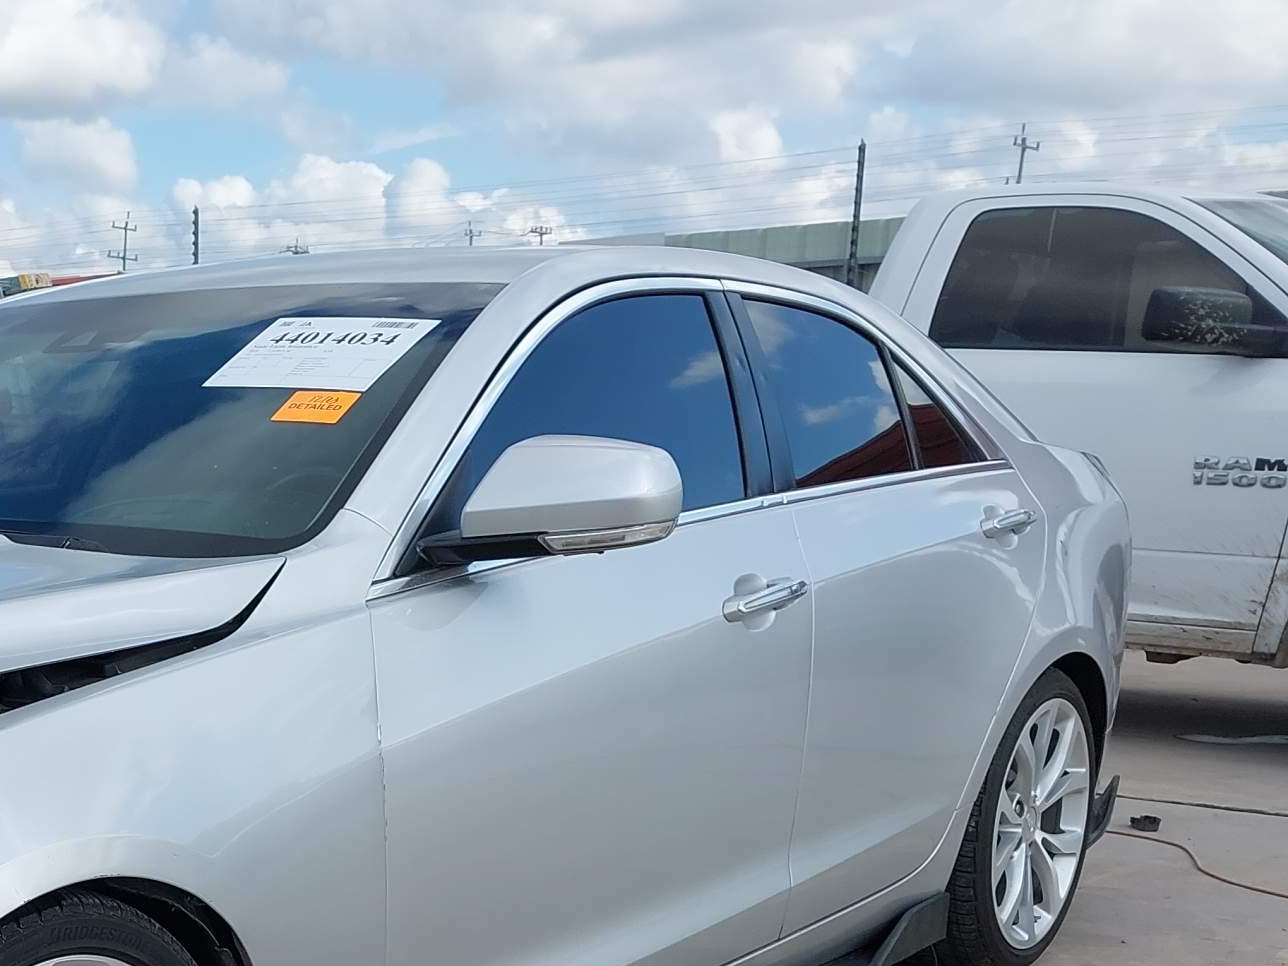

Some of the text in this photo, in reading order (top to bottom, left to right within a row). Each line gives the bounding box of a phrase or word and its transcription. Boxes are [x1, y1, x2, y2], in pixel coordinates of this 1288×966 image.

[269, 331, 402, 346] 44014034
[287, 402, 343, 411] DETAILED
[1192, 456, 1288, 472] RAM
[1192, 471, 1288, 489] 1500
[49, 925, 148, 953] BRIDGESTON
